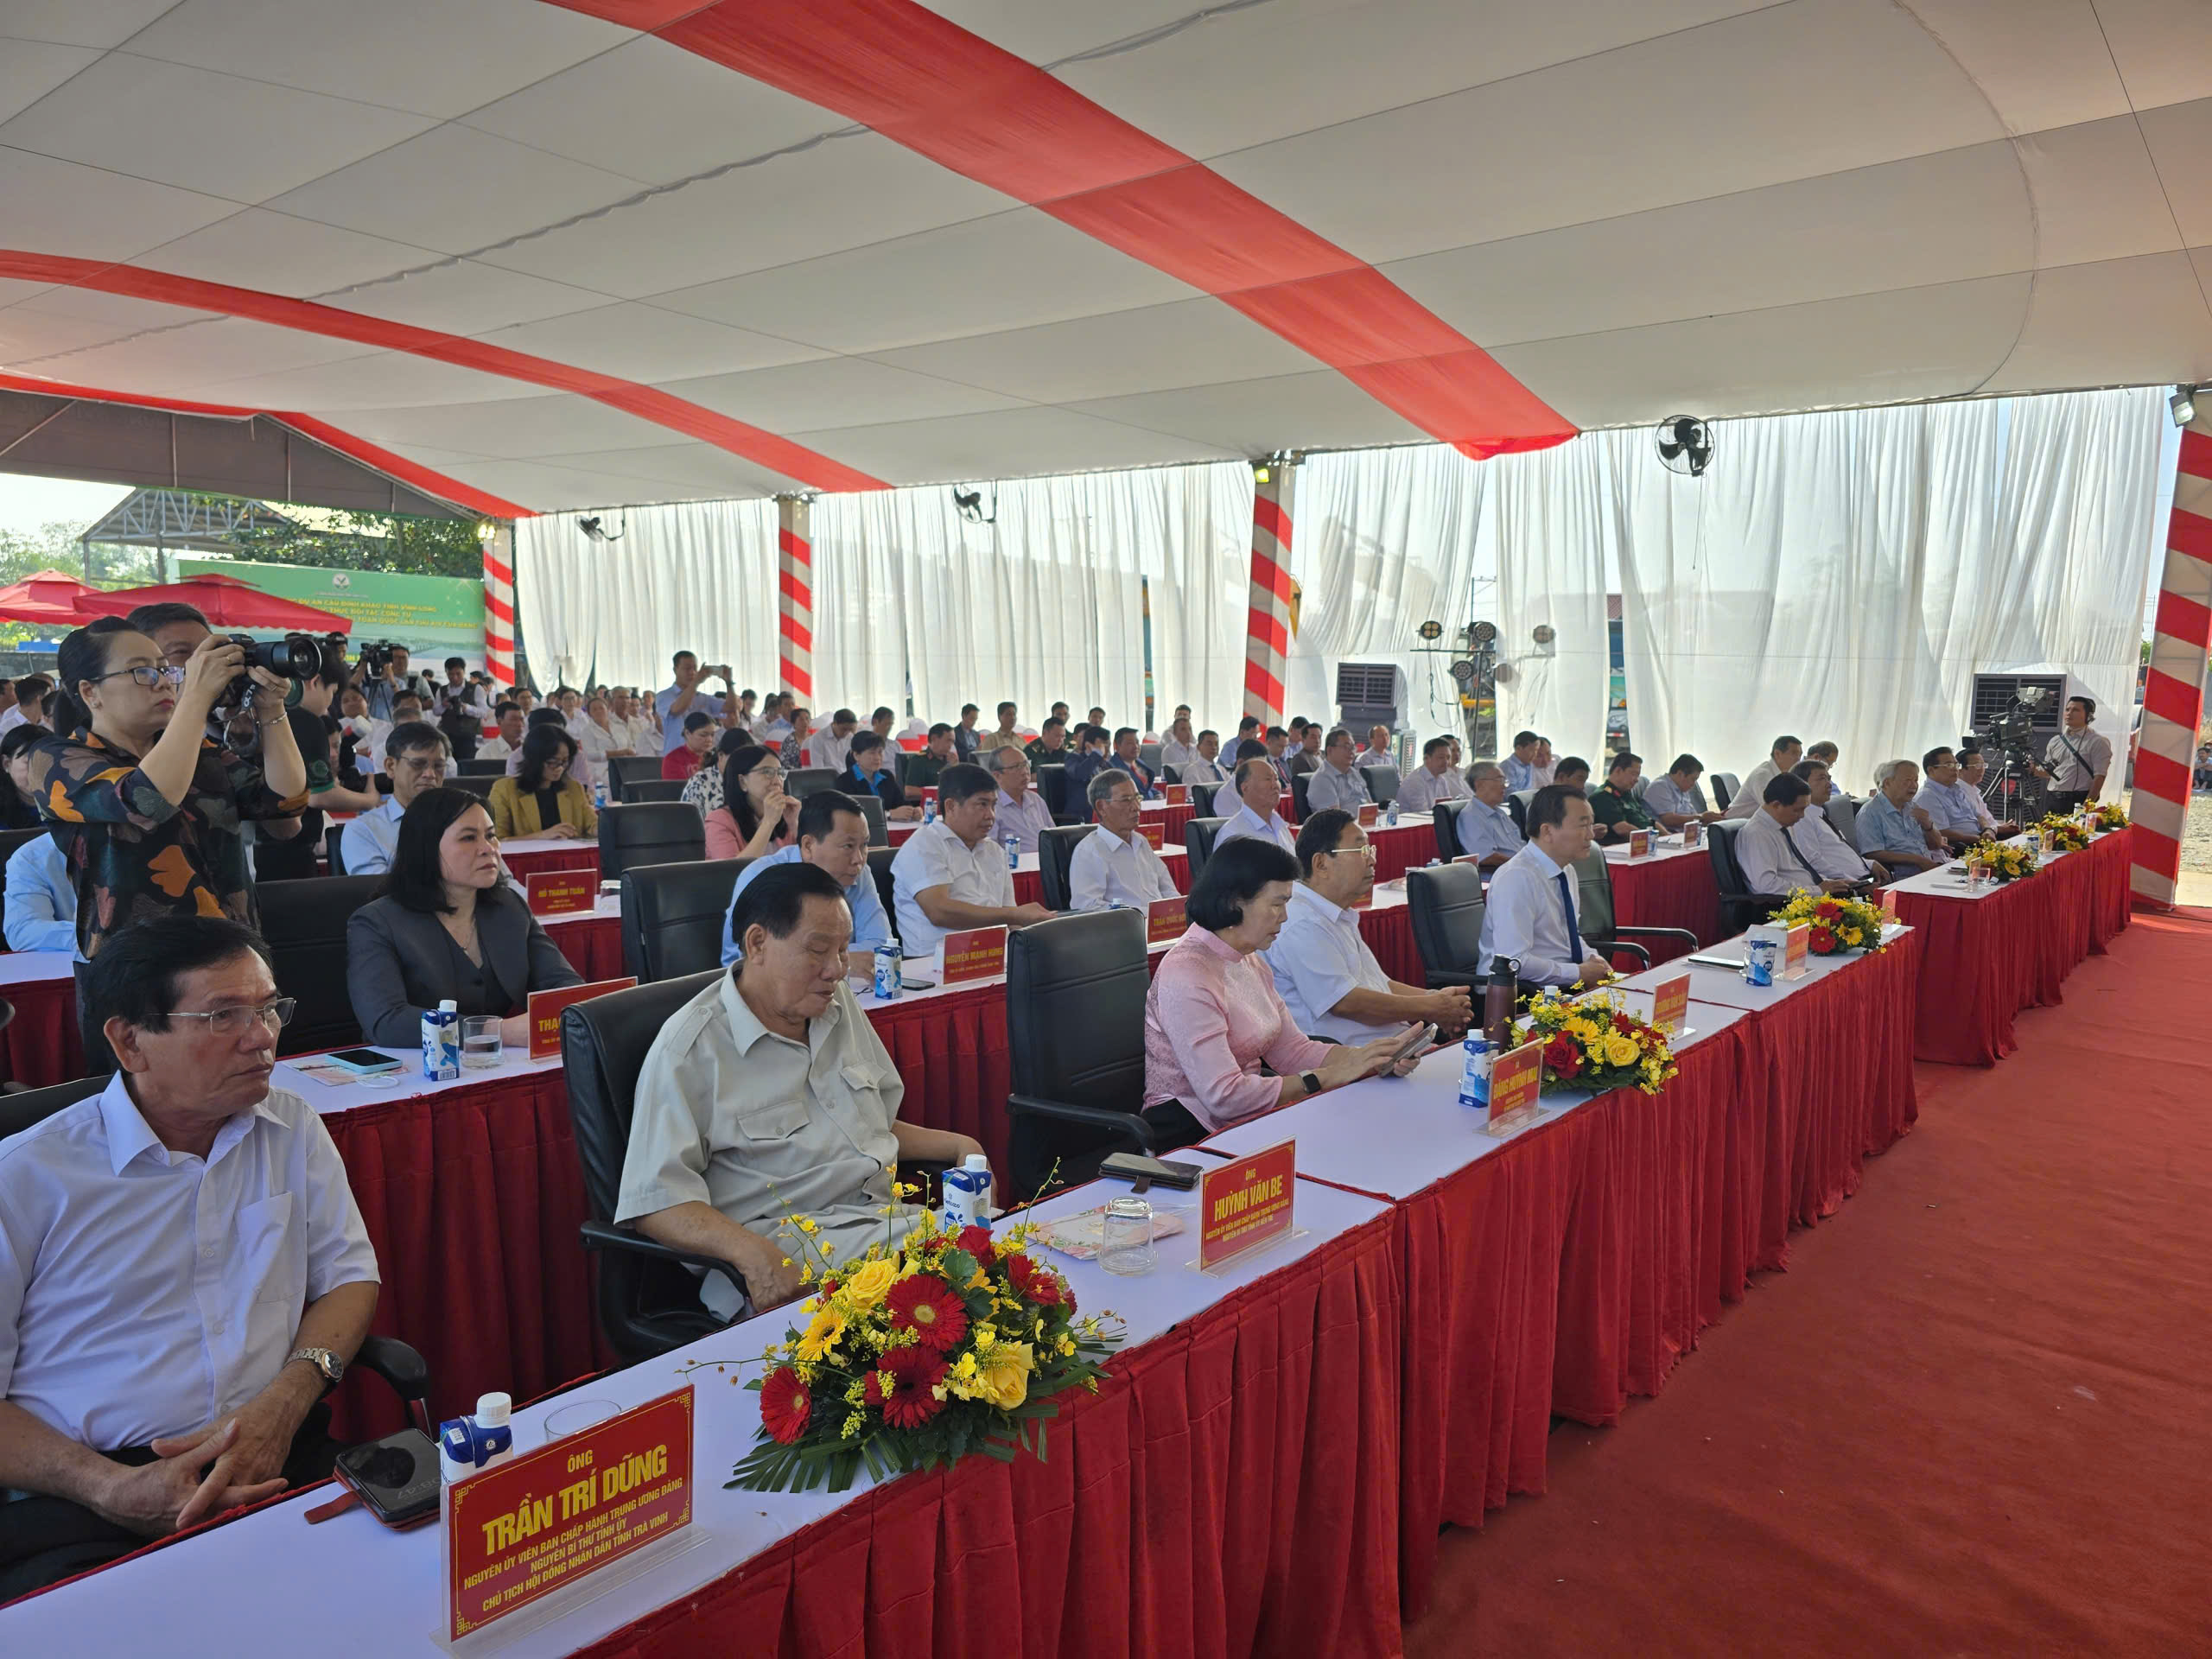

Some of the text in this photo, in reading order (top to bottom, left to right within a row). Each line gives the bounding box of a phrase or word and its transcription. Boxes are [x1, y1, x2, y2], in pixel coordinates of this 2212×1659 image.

[1215, 1191, 1249, 1222] HUỲNH
[1249, 1179, 1269, 1206] VĂN
[1245, 1168, 1256, 1181] ÔNG
[567, 1449, 594, 1473] ÔNG
[482, 1443, 668, 1556] TRẦN TRÍ DŨNG
[464, 1477, 683, 1590] NGUYÊN ỦY VIÊN BAN CHẤP HÀNH TRUNG ƯƠNG ĐẢNG
[482, 1511, 669, 1612] CHỦ TỊCH HỘI ĐỒNG NHÂN DÂN TỈNH TRÀ VINH
[531, 1516, 628, 1573] NGUYÊN BÍ THƯ TỈNH ỦY
